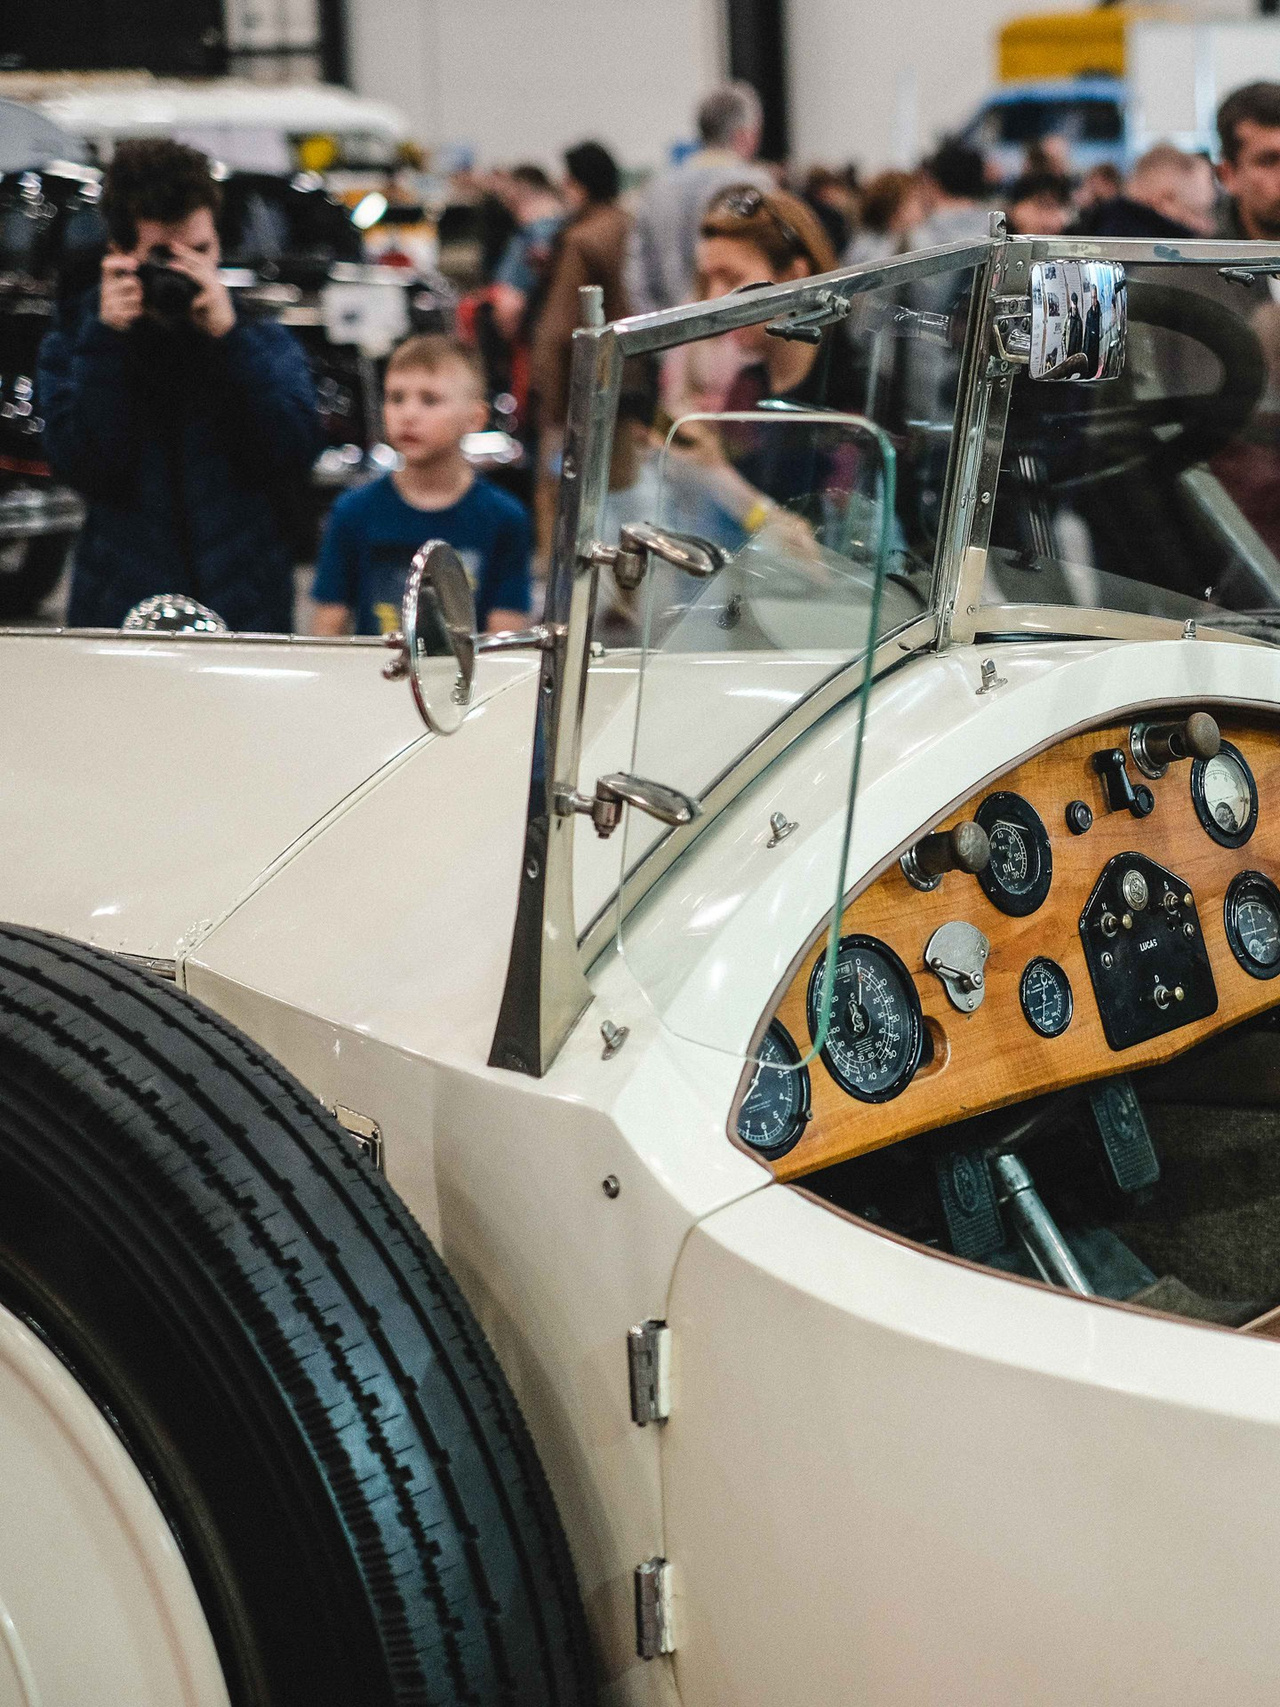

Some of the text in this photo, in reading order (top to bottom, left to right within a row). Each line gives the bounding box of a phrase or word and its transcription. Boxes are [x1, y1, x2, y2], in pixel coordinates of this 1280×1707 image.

[1002, 861, 1016, 873] OIL
[1101, 902, 1108, 911] H
[1139, 938, 1158, 951] LUCAS
[777, 1070, 783, 1079] 3
[772, 1110, 779, 1119] 5
[745, 1120, 751, 1129] 7
[760, 1121, 767, 1130] 6
